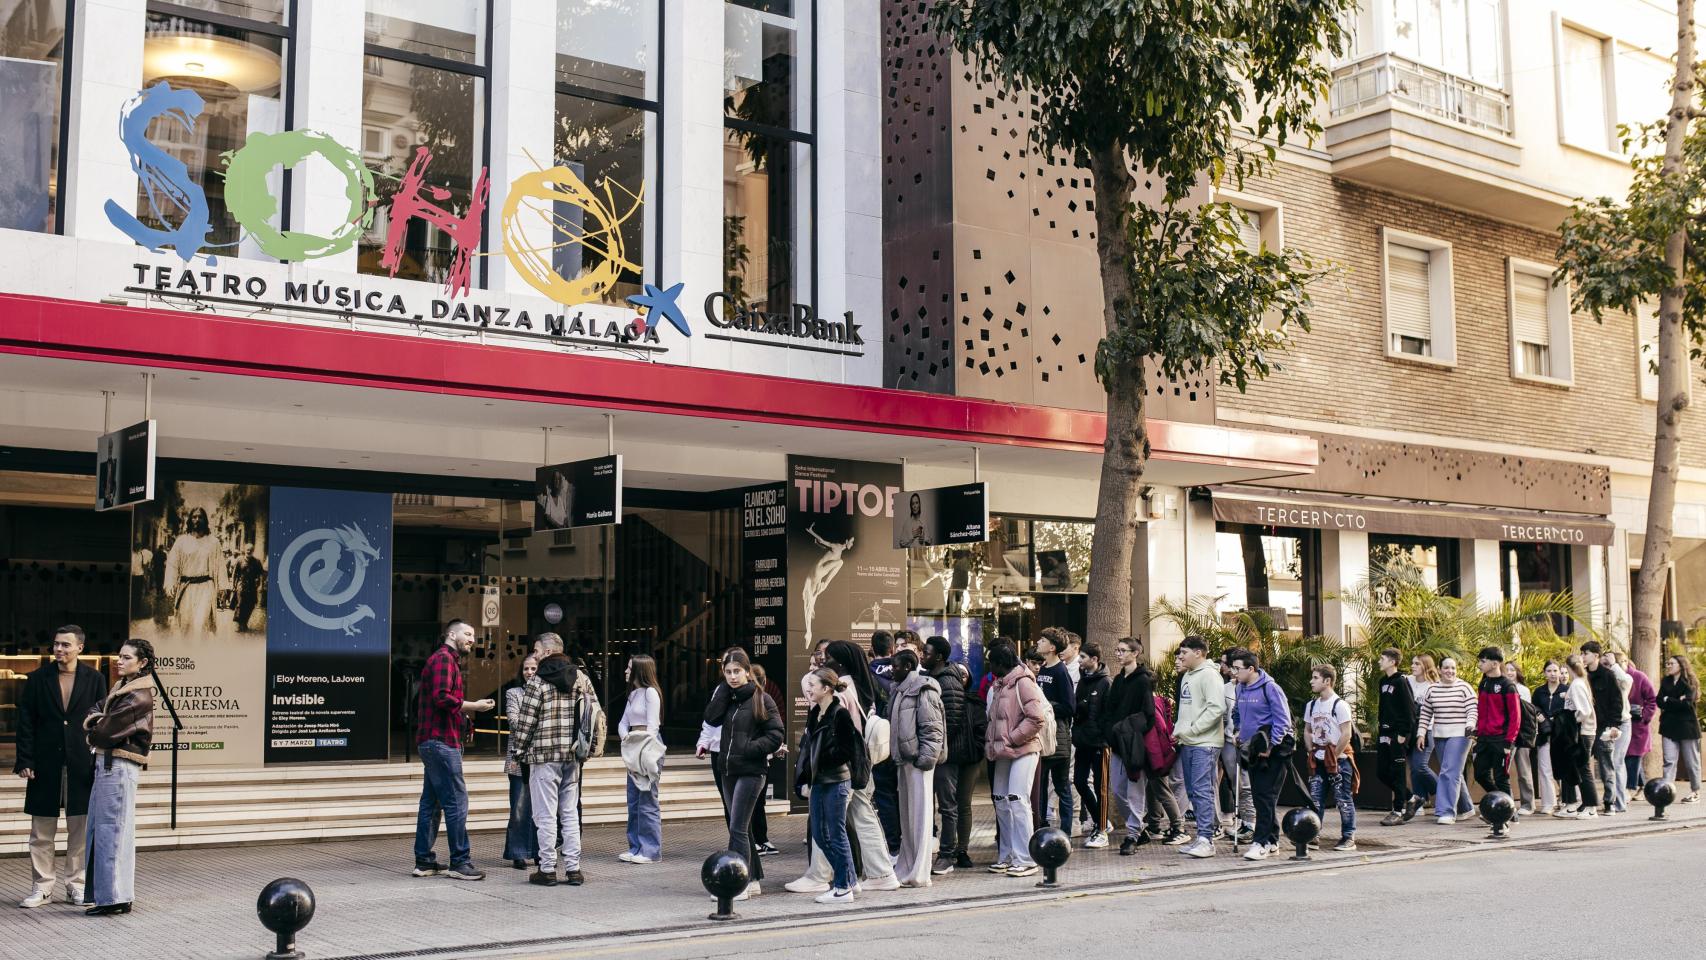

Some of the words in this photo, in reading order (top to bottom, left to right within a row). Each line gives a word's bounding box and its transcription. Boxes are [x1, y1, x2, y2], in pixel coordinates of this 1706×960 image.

[104, 80, 645, 306] SOHO
[133, 263, 267, 298] TEATRO
[285, 280, 407, 314] MÚSICA
[432, 299, 533, 329] DANZA
[704, 291, 865, 345] CaixaBank
[745, 490, 776, 507] FLAMENCO
[745, 509, 754, 527] EN
[756, 507, 764, 526] EL
[766, 505, 785, 525] SOHO
[755, 616, 775, 626] ARGENTINA
[153, 657, 174, 667] RIOS
[276, 675, 295, 684] Eloy
[297, 675, 330, 683] Moreno,
[331, 675, 365, 683] LaJoven
[151, 686, 222, 698] ONCIERTO
[273, 693, 325, 705] Invisible
[161, 700, 240, 711] CUARESMA
[195, 741, 220, 749] MÚSICA
